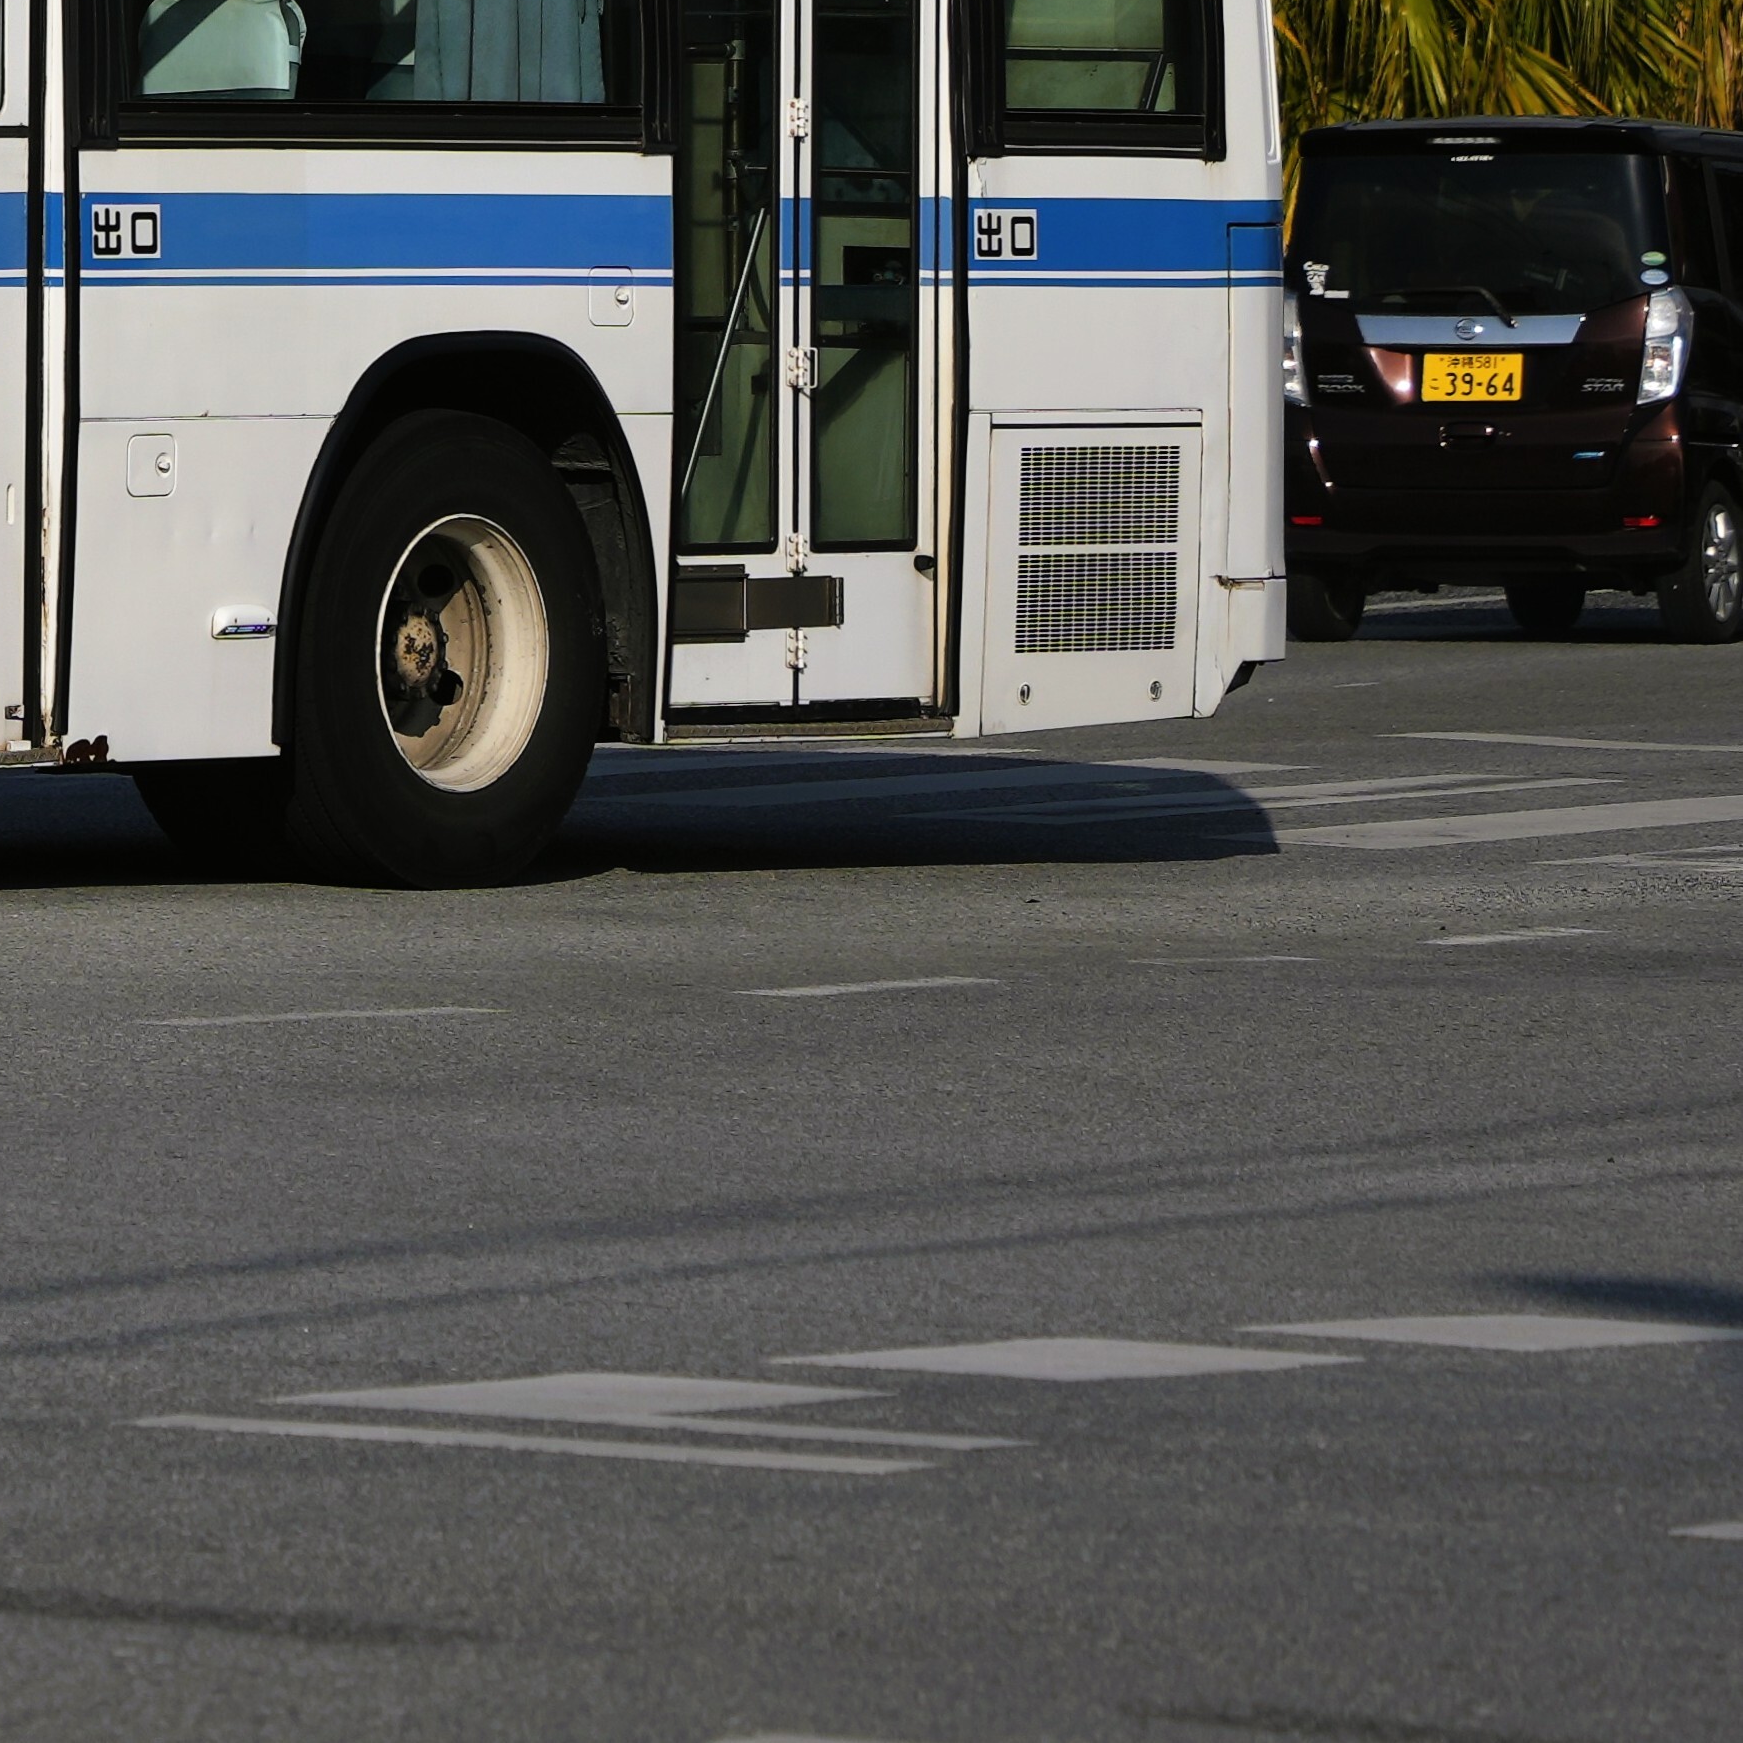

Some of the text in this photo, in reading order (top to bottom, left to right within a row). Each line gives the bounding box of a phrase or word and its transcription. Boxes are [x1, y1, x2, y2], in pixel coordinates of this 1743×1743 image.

[93, 207, 158, 256] 出口
[977, 212, 1035, 257] 出口
[1444, 372, 1514, 396] 39-64
